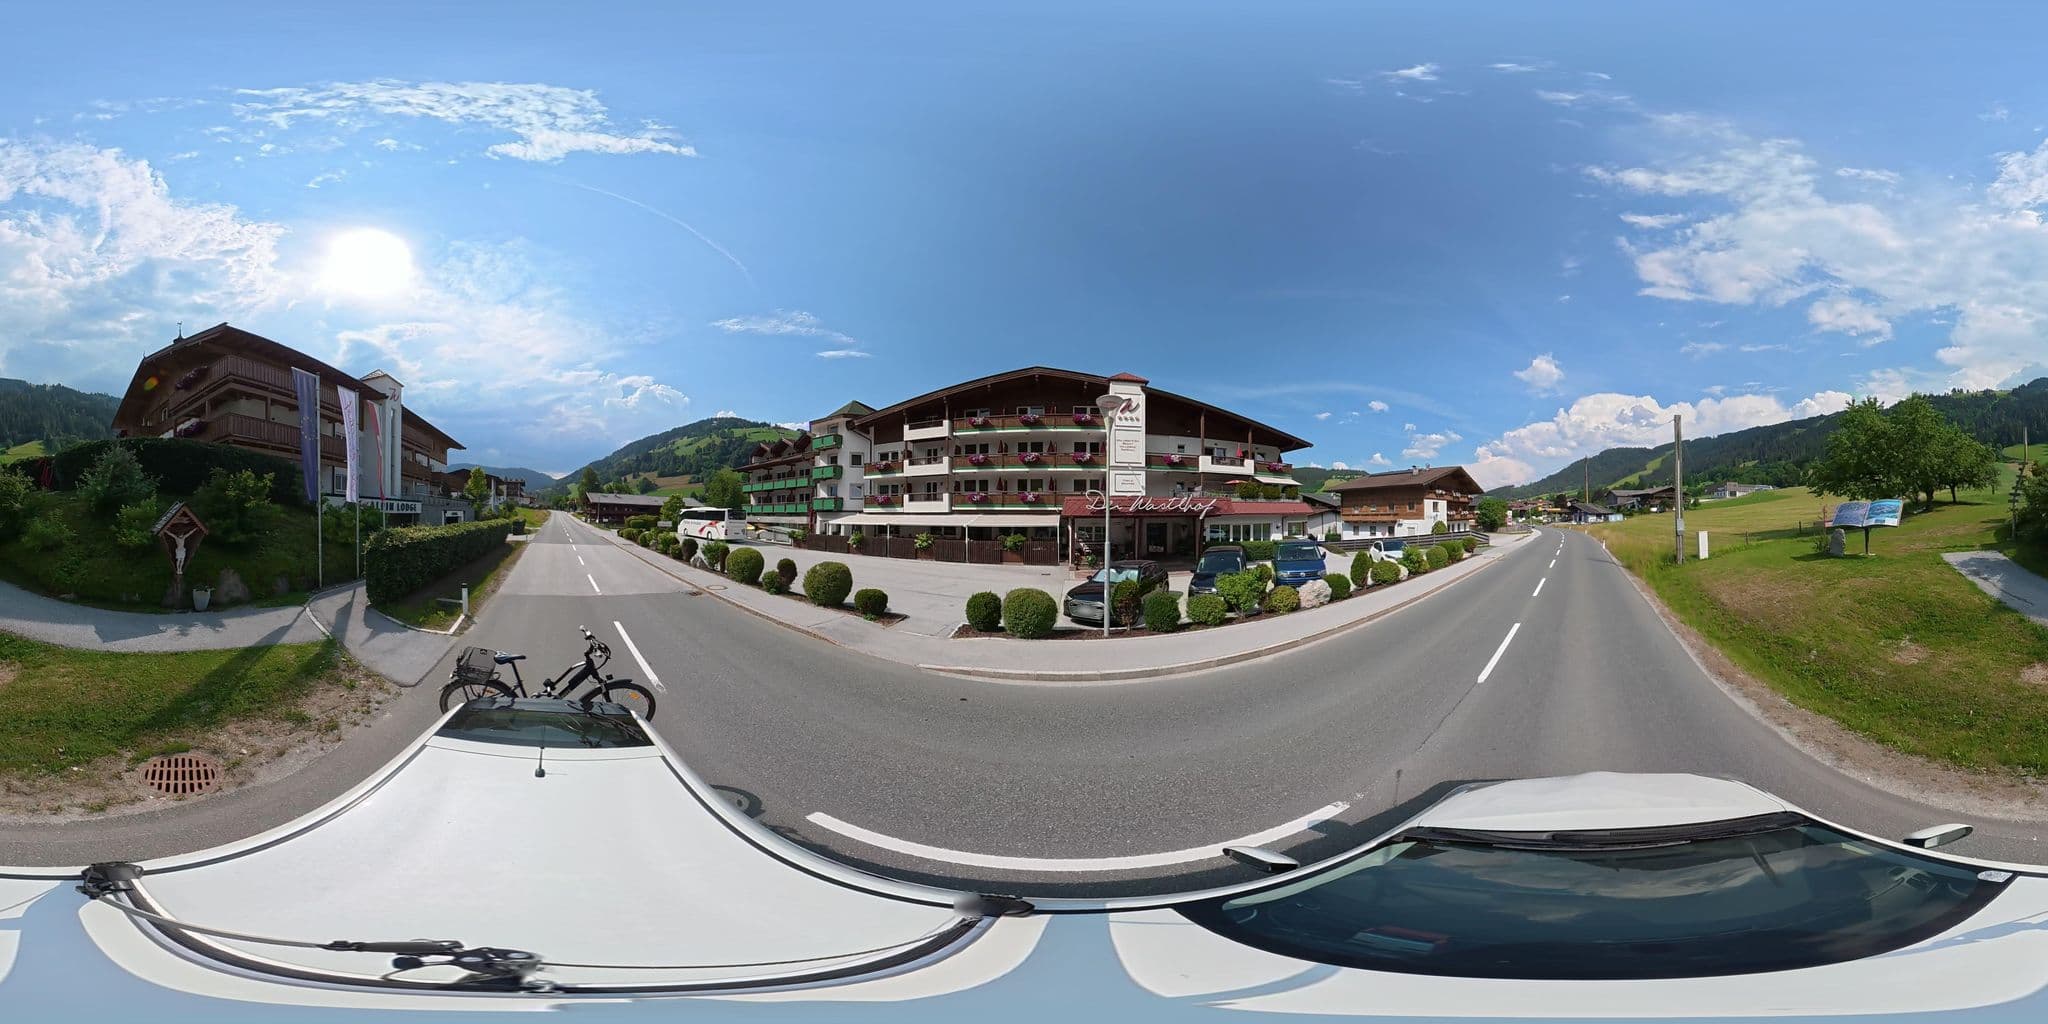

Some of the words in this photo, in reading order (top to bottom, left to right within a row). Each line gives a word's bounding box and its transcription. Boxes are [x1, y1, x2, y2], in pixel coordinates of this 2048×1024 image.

[397, 502, 417, 512] LODGE
[1085, 490, 1123, 509] Dr
[1129, 494, 1217, 519] Wastlhof
